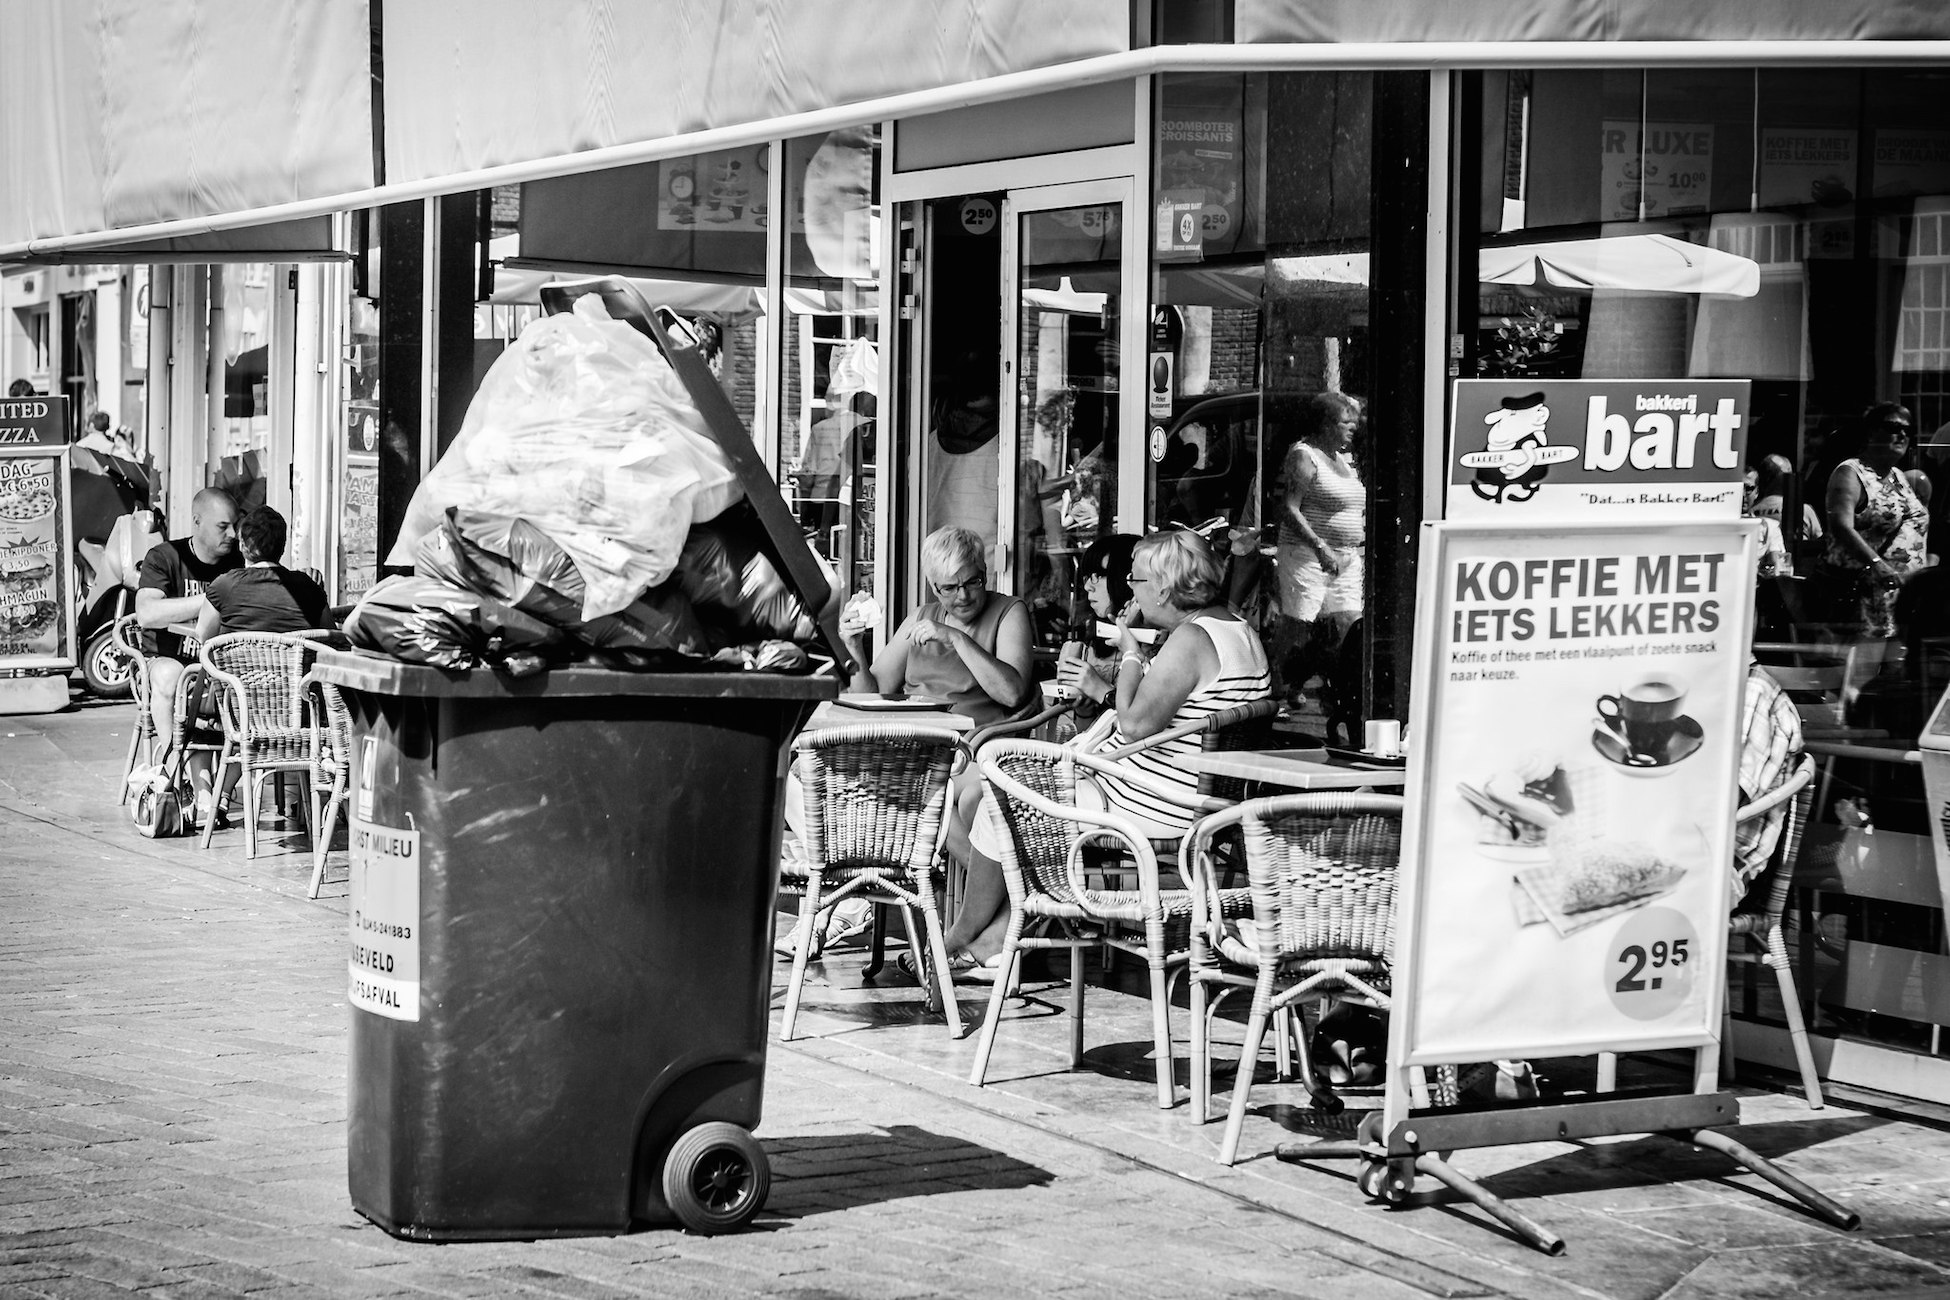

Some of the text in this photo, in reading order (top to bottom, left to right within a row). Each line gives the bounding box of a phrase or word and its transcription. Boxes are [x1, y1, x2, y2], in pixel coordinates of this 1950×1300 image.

[1160, 120, 1234, 132] ROOMBOTER
[1160, 131, 1233, 142] CROISSANTS
[1765, 136, 1850, 149] KOFFIE MET
[1795, 150, 1850, 162] LEKKERS
[1635, 394, 1698, 414] bakkerij
[1583, 394, 1743, 473] bart
[0, 461, 32, 479] DAG
[1639, 491, 1689, 505] Bakker
[1455, 553, 1726, 602] KOFFIE MET
[1452, 600, 1721, 643] IETS LEKKERS
[1451, 650, 1488, 664] Koffie
[1489, 649, 1503, 663] of
[1505, 649, 1531, 662] thee
[1534, 647, 1557, 661] met
[1559, 648, 1580, 660] een
[1637, 642, 1650, 656] of
[1650, 641, 1682, 656] zoete
[1684, 640, 1718, 655] snack
[1450, 668, 1520, 682] naar keuze.
[371, 834, 413, 859] MILIEU
[1615, 938, 1689, 993] 2.95
